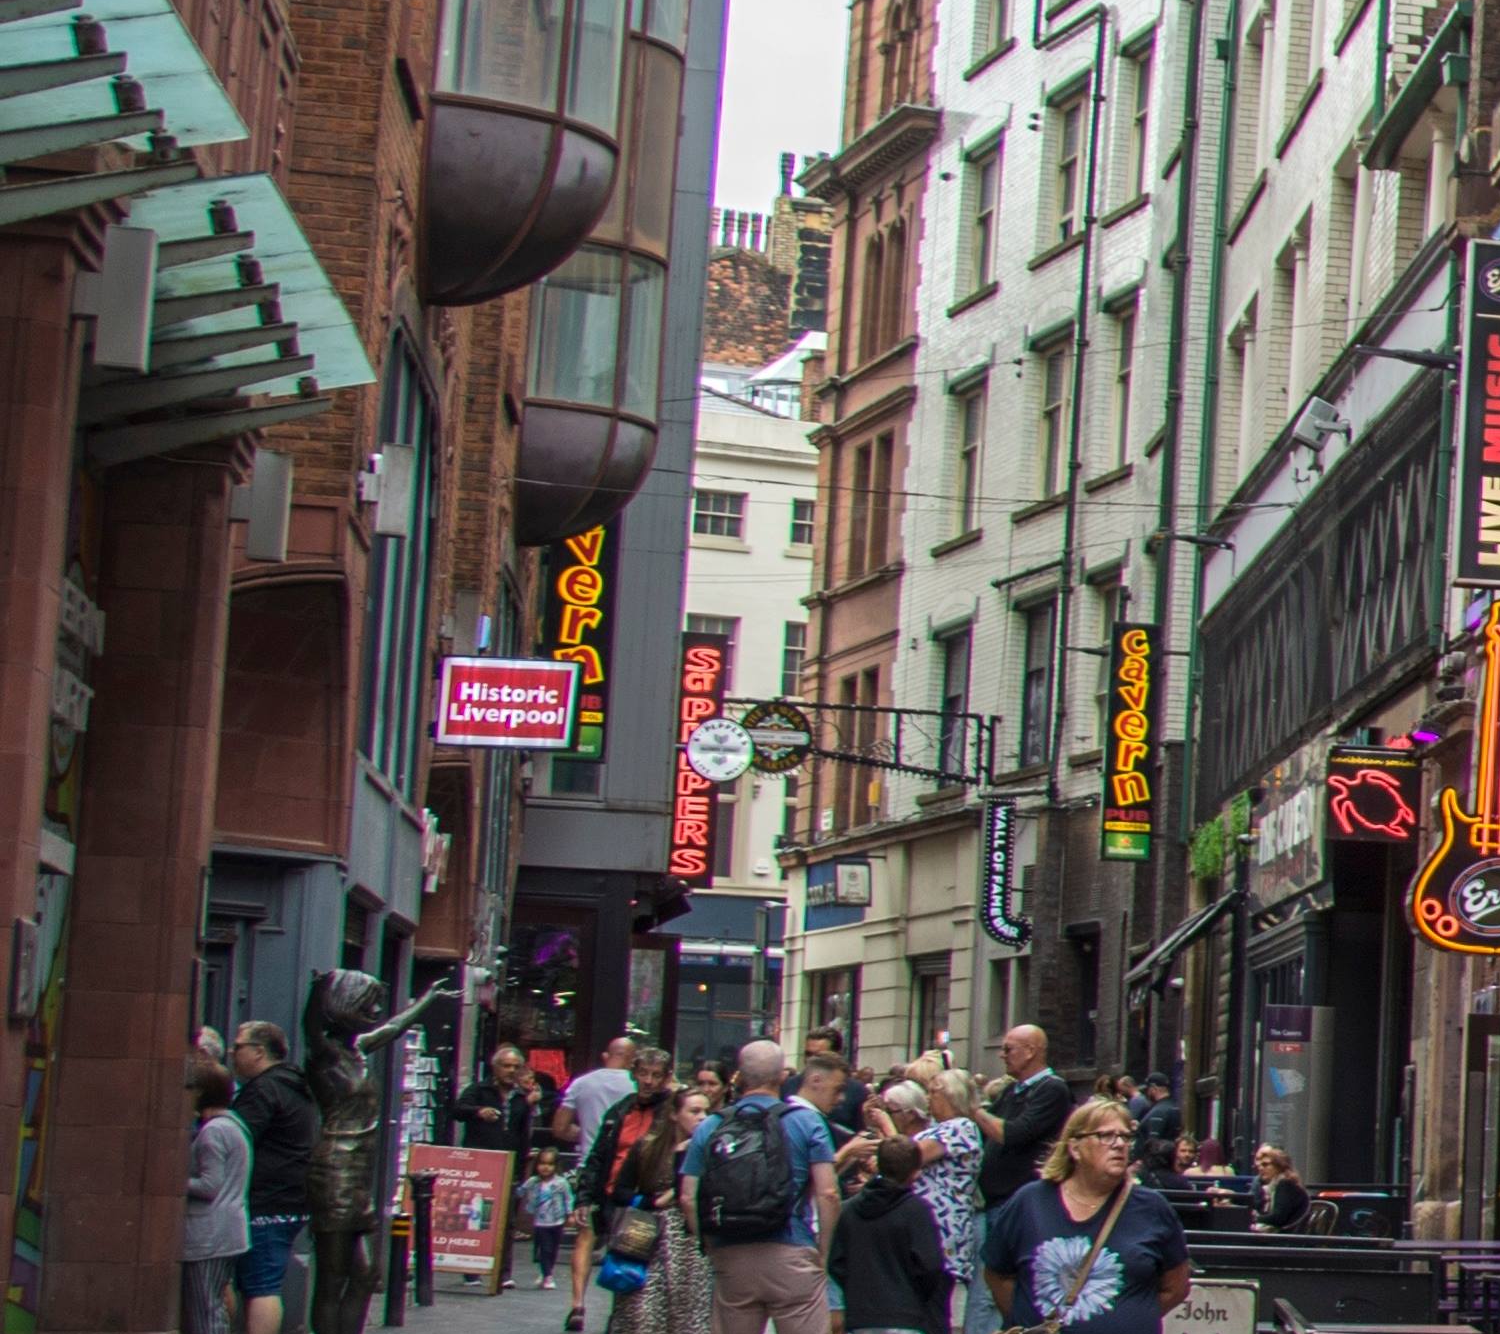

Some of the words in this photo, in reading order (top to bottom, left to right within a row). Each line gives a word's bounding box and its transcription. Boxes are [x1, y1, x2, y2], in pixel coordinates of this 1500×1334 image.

[554, 524, 606, 685] vern
[459, 681, 559, 704] Historic
[449, 702, 566, 728] Liverpool
[1114, 628, 1150, 806] cavern
[670, 697, 716, 875] PPERS
[993, 806, 1008, 848] WALL
[1105, 808, 1149, 821] PUB
[992, 850, 1006, 872] OF
[989, 874, 1005, 917] FAME
[992, 915, 1020, 939] BAR
[437, 1177, 459, 1187] OFT
[461, 1179, 493, 1189] DRINK
[1174, 1300, 1229, 1325] John
